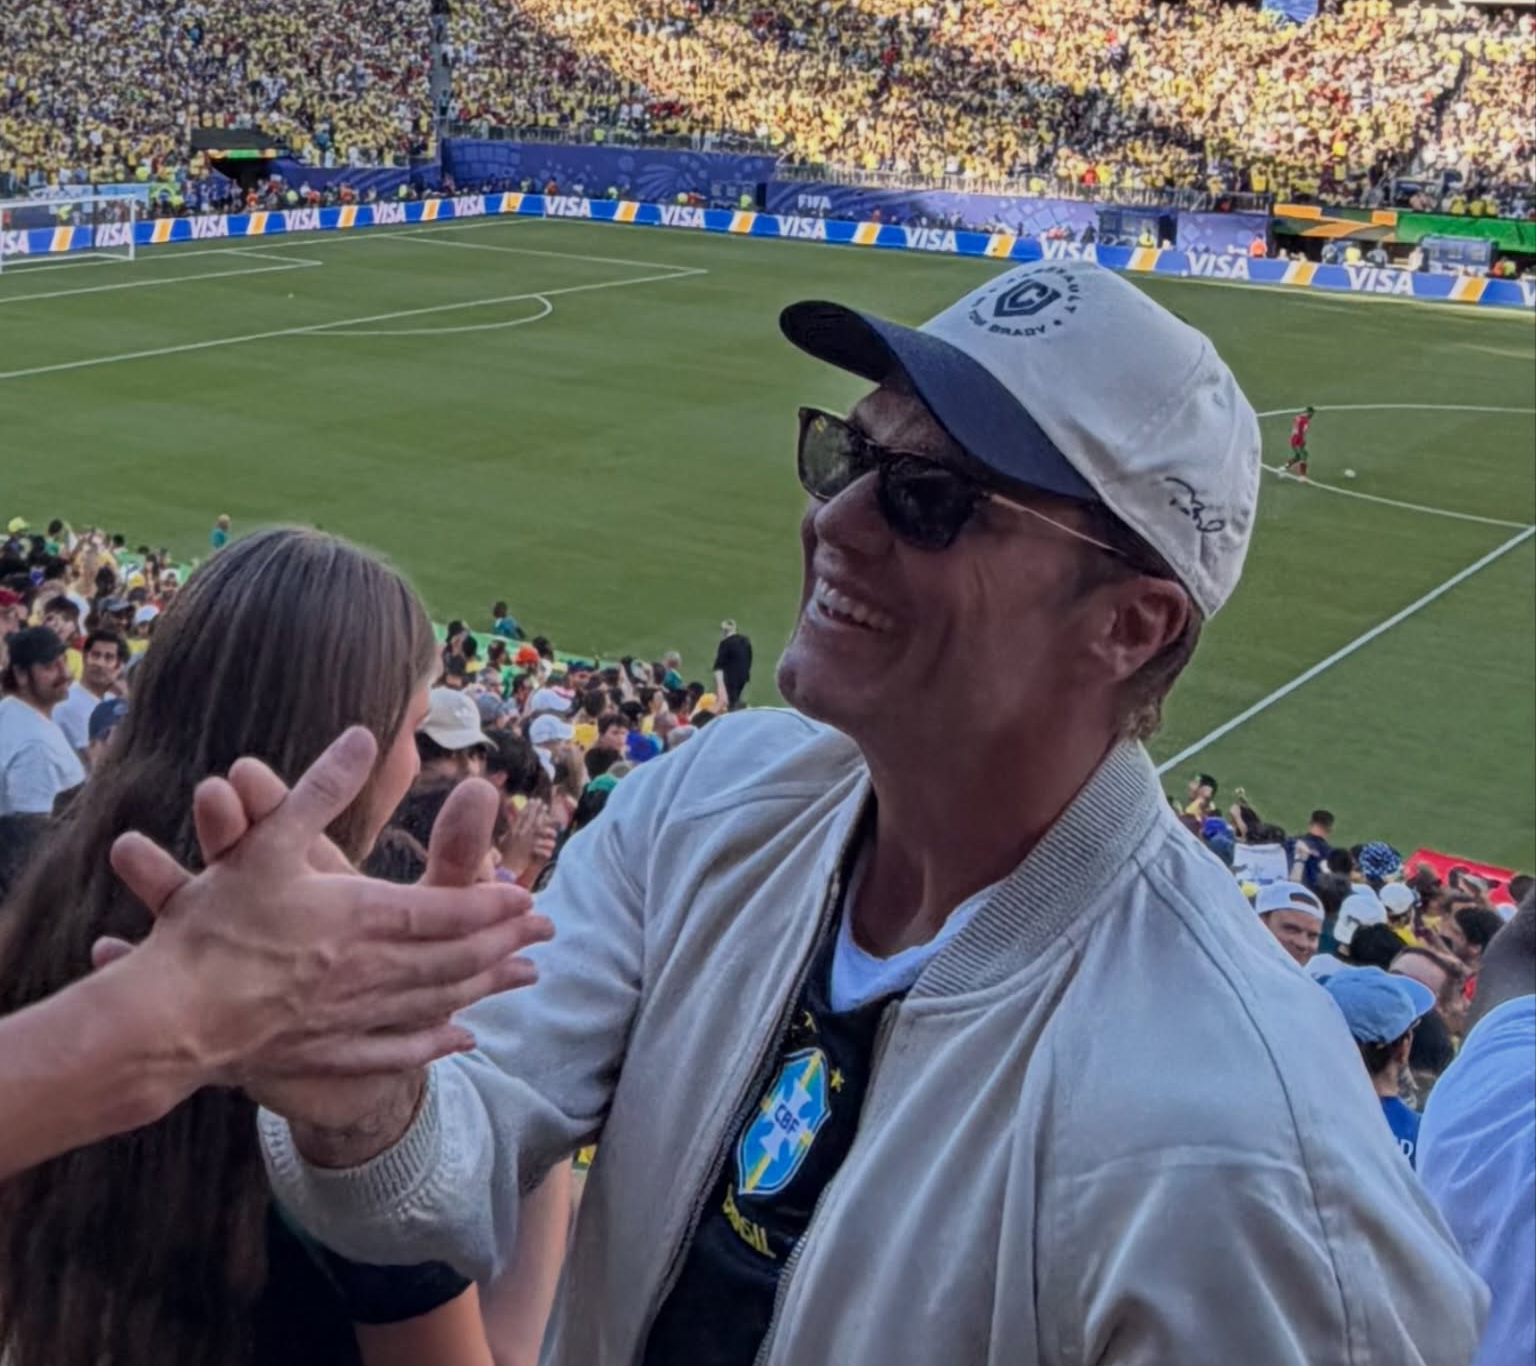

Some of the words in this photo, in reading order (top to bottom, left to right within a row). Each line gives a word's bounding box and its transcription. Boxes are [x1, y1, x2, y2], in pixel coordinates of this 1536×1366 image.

[373, 202, 407, 224] VISA
[452, 195, 485, 216] VISA
[544, 196, 591, 218] VISA
[798, 194, 832, 210] FIFA
[189, 215, 229, 239] VISA
[284, 208, 321, 231] VISA
[660, 205, 706, 228] VISA
[778, 215, 826, 239] VISA
[905, 227, 957, 252] VISA
[1040, 236, 1099, 262] VISA
[1185, 251, 1250, 279] VISA
[1345, 264, 1413, 295] VISA
[774, 1103, 800, 1134] CBF
